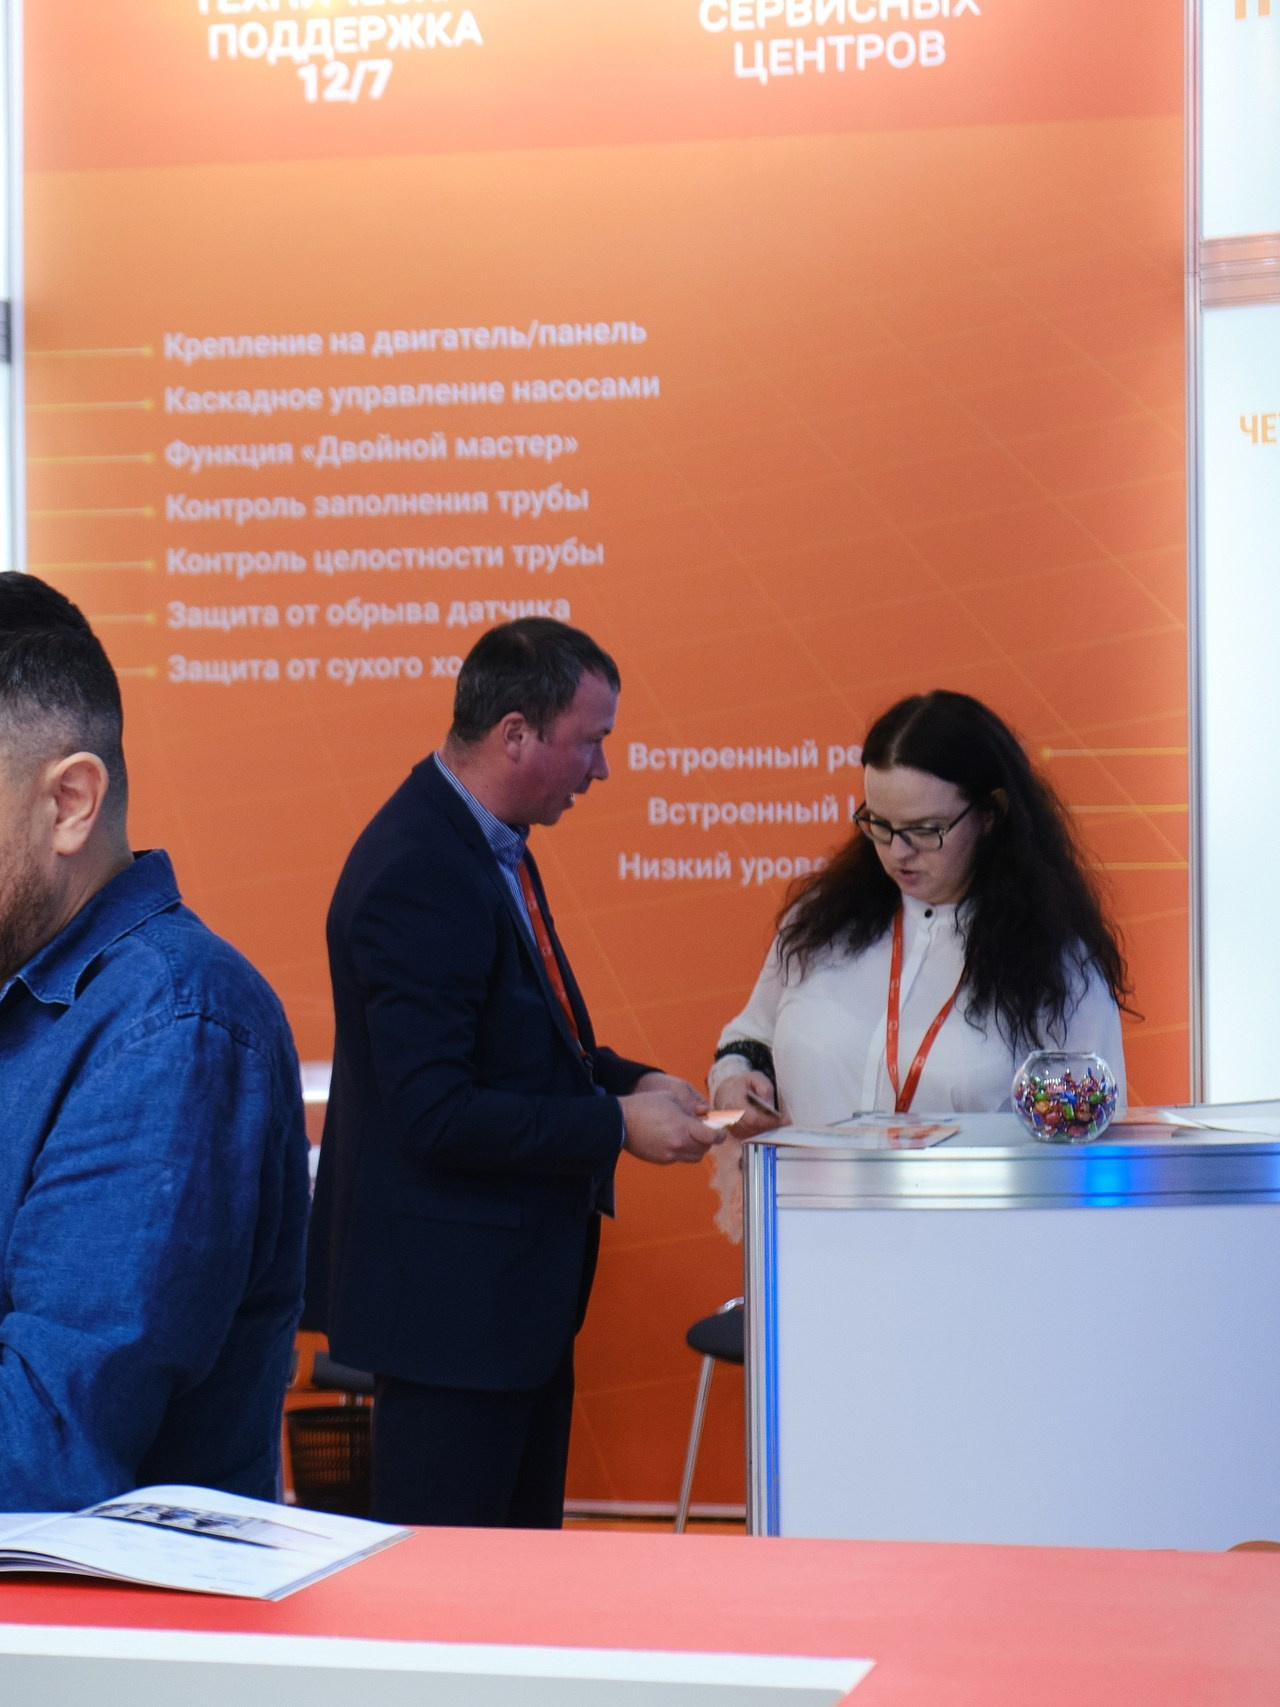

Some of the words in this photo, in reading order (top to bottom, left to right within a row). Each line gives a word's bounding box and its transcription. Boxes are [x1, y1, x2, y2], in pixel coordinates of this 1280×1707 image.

[207, 10, 484, 65] ПОДДЕРЖКА
[733, 29, 947, 86] ЦЕНТРОВ
[297, 58, 393, 103] 12/7
[164, 331, 323, 367] Крепление
[329, 331, 366, 357] на
[372, 319, 648, 358] двигатель/панель
[165, 385, 324, 416] Каскадное
[328, 379, 506, 416] управление
[512, 375, 660, 401] насосами
[1239, 412, 1280, 445] ЧЕ
[165, 438, 294, 474] Функция
[301, 431, 448, 468] «Двойной
[455, 433, 579, 463] мастер»
[166, 492, 307, 525] Контроль
[314, 490, 488, 519] заполнения
[496, 481, 589, 519] трубы
[166, 547, 308, 580] Контроль
[314, 544, 505, 577] целостности
[512, 537, 605, 573] трубы
[168, 600, 280, 633] Защита
[286, 602, 320, 627] от
[326, 596, 440, 631] обрыва
[447, 598, 570, 628] датчика
[169, 655, 280, 686] Защита
[287, 657, 320, 682] от
[326, 655, 424, 686] сухого
[431, 654, 464, 678] хо
[628, 738, 820, 777] Встроенный
[647, 794, 839, 832] Встроенный
[618, 850, 732, 881] Низкий
